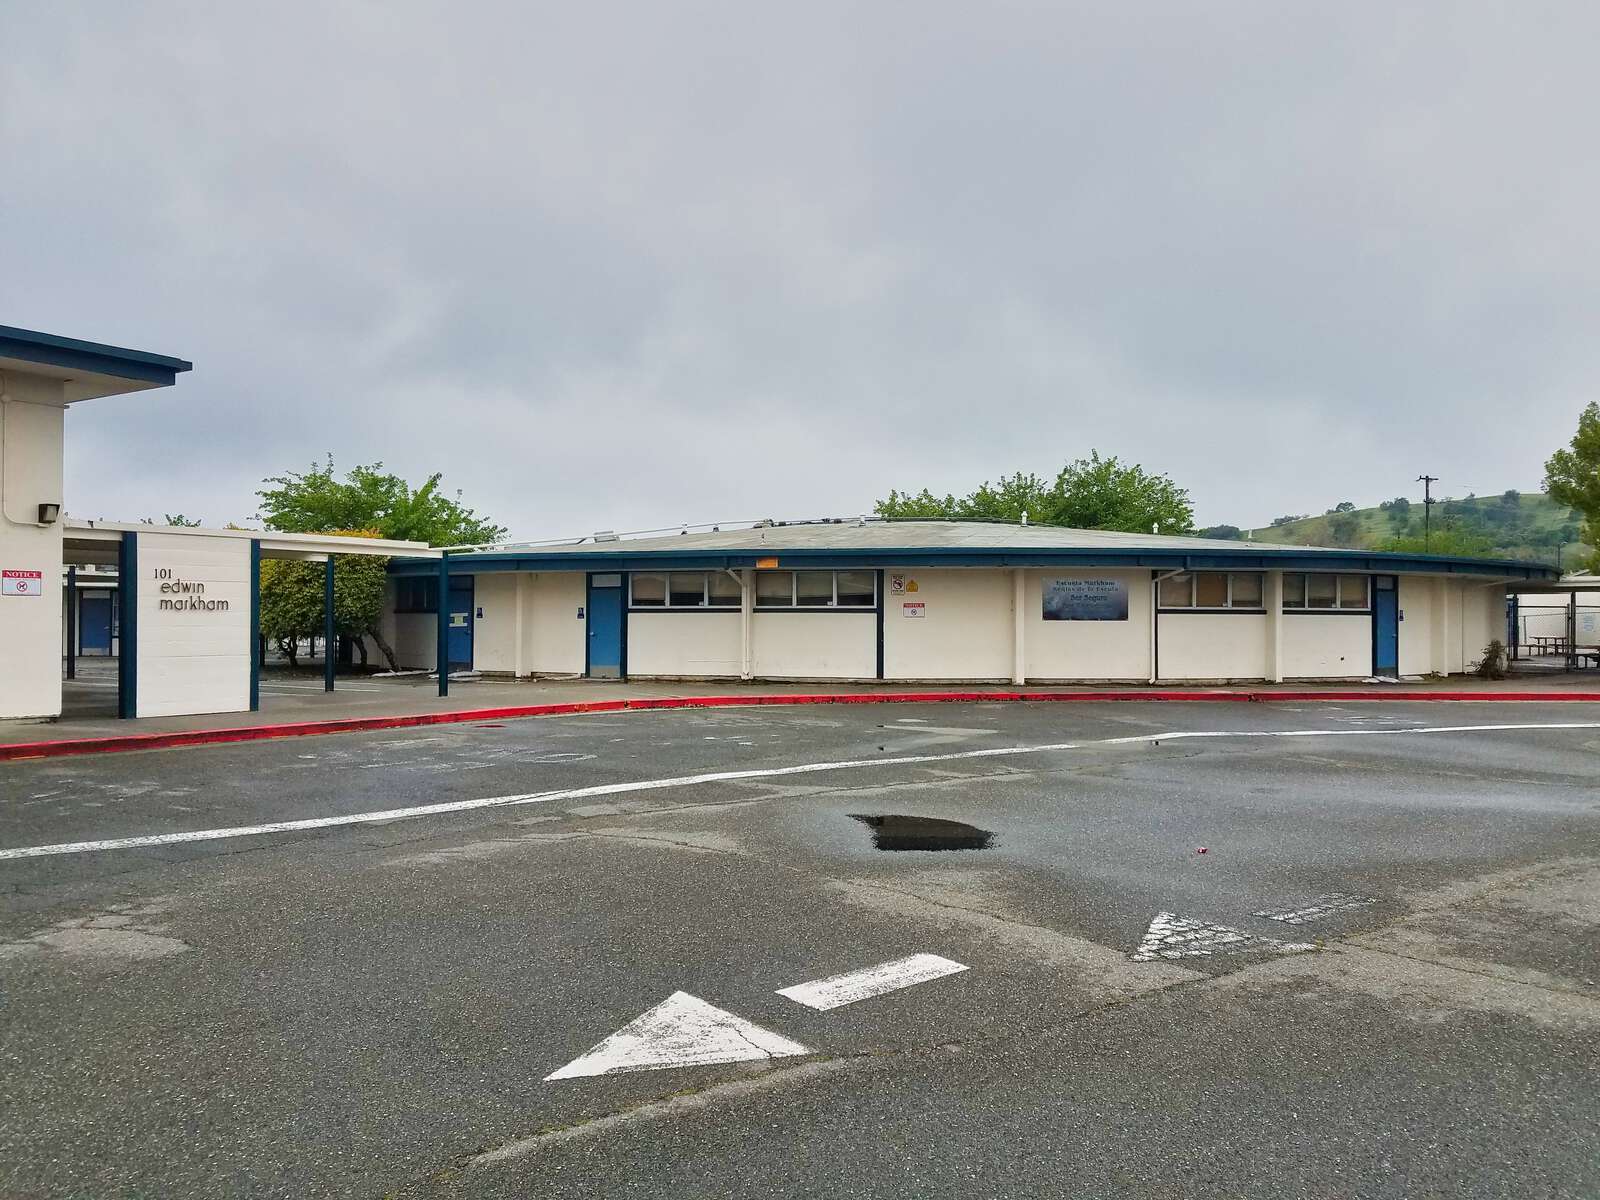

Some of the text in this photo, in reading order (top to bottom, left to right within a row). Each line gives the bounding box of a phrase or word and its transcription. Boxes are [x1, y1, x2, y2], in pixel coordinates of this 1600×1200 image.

[154, 568, 172, 579] 101
[160, 578, 205, 593] edwin
[160, 595, 229, 611] markham
